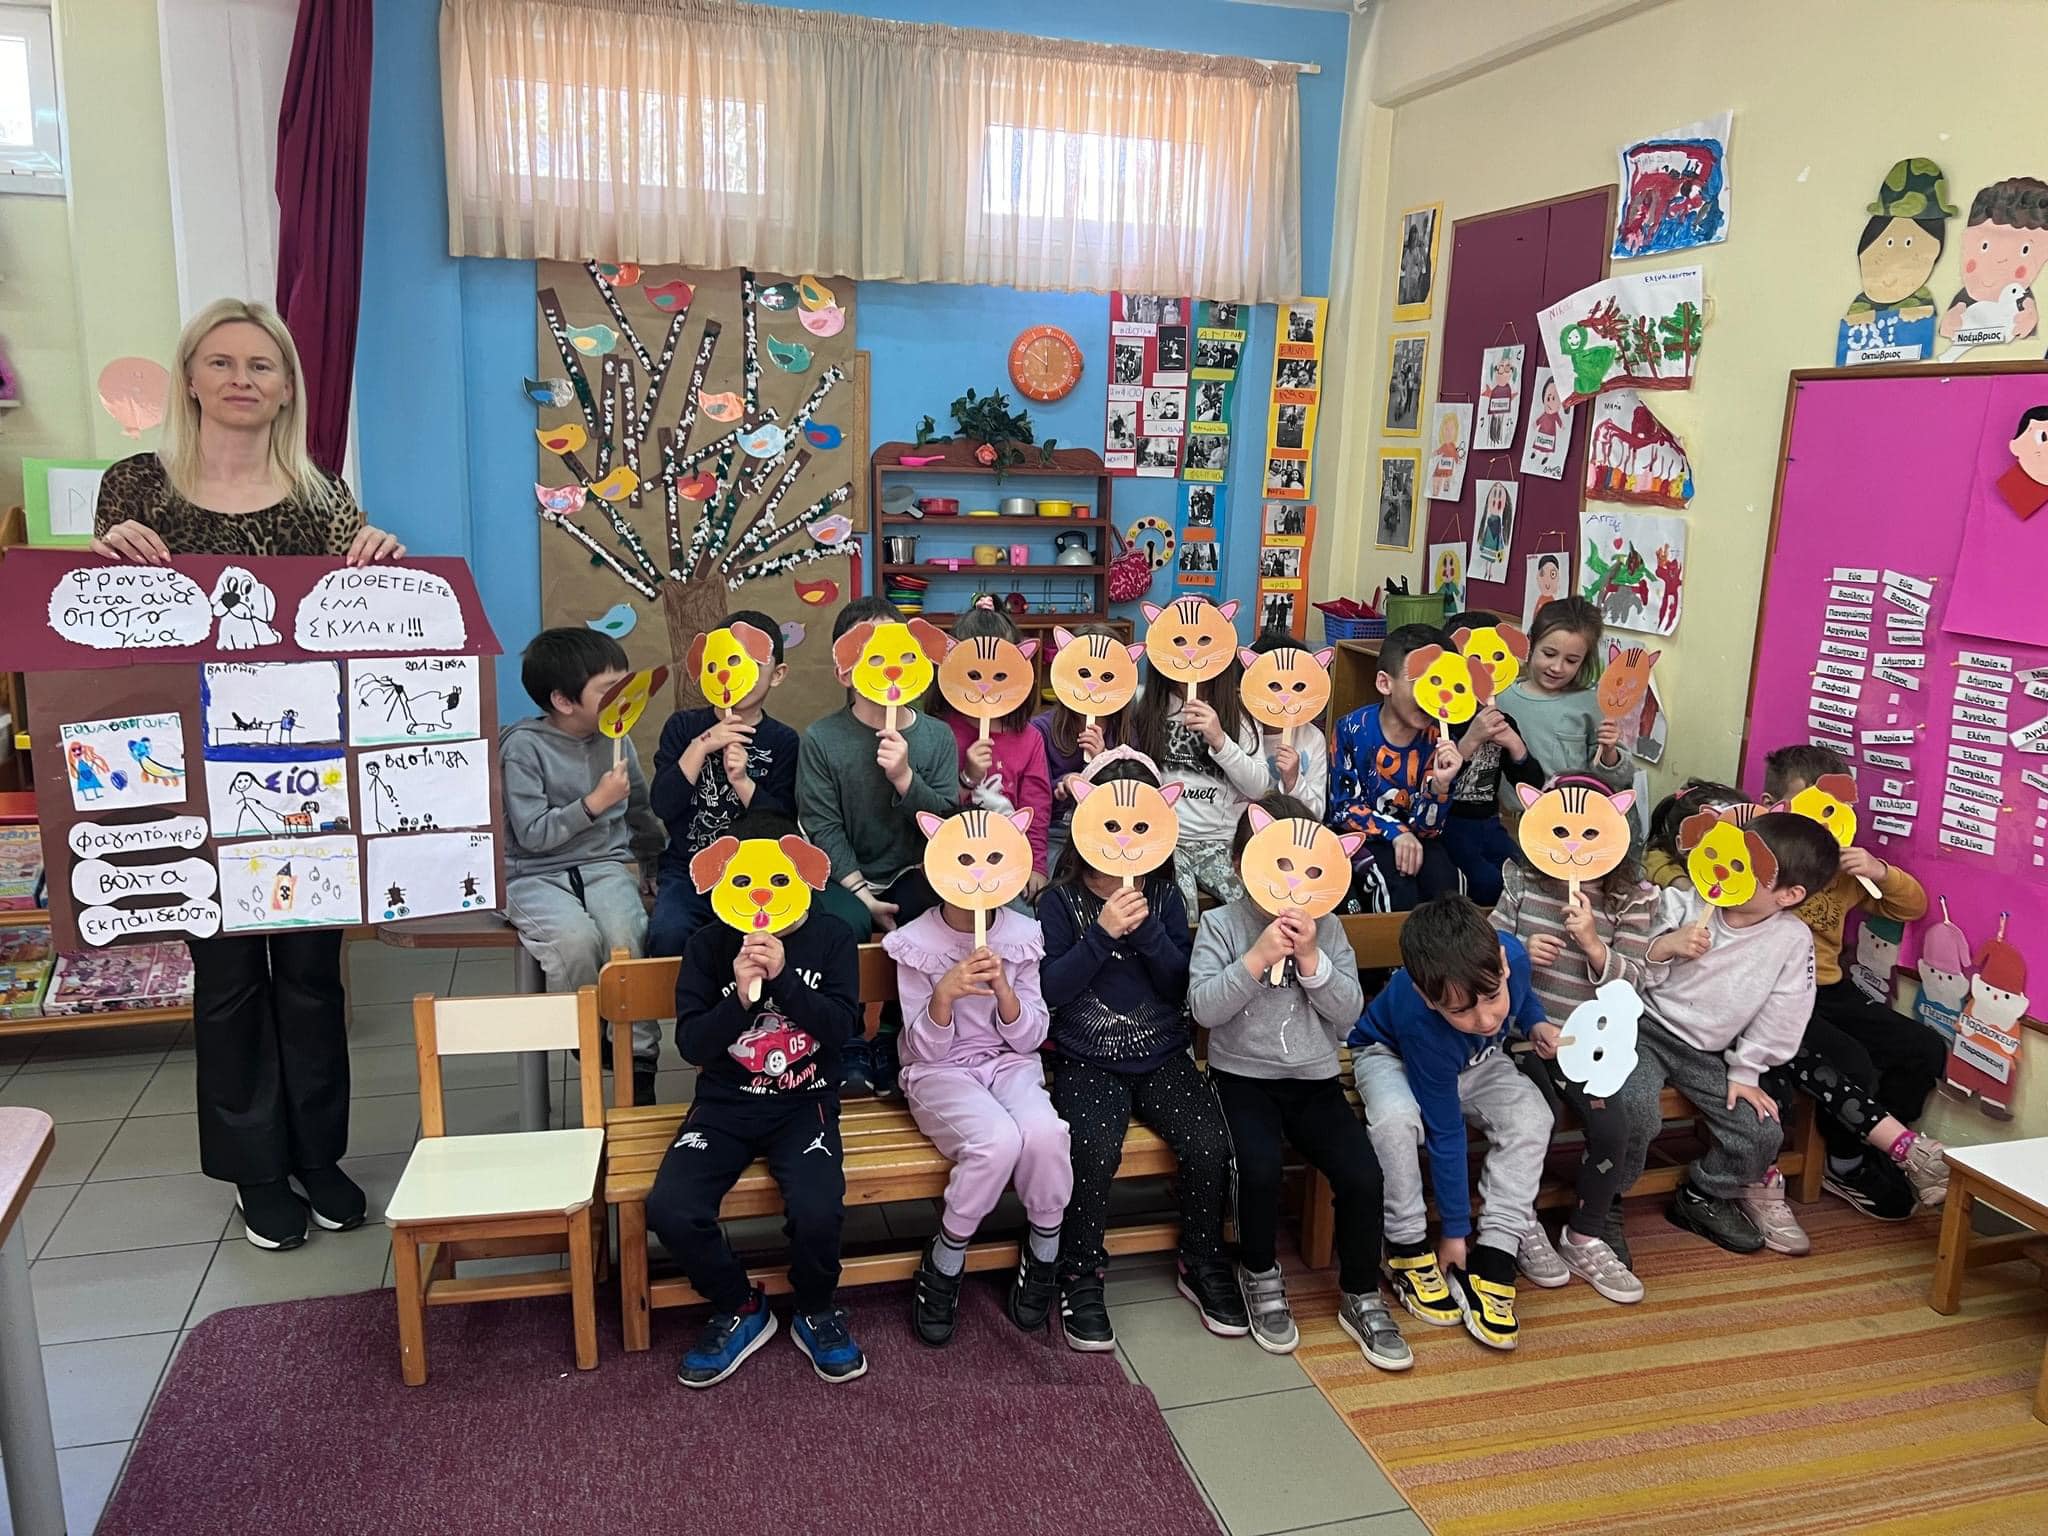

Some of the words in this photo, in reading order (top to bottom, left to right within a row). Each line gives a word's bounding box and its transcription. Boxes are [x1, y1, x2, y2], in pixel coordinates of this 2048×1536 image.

[1957, 331, 2001, 343] Νοέμβριος
[1861, 350, 1901, 361] Οκτώβριος
[1881, 657, 1916, 667] Δήμητρα
[1970, 656, 1998, 669] Μαρία
[1826, 665, 1854, 677] Πέτρος
[1882, 670, 1908, 688] Πέτρος
[1967, 675, 2003, 689] Δήμητρα
[1821, 681, 1851, 694] Ραφαήλ
[1964, 692, 1996, 707] Ιωάννα
[1967, 730, 1991, 743] Ελένη
[1953, 765, 1995, 784] Πασχάλης
[1949, 782, 1999, 804] Παναγιώτης
[1957, 820, 1981, 834] Νικόλ
[1950, 835, 1983, 851] Εβελίνα
[789, 1033, 808, 1054] 05
